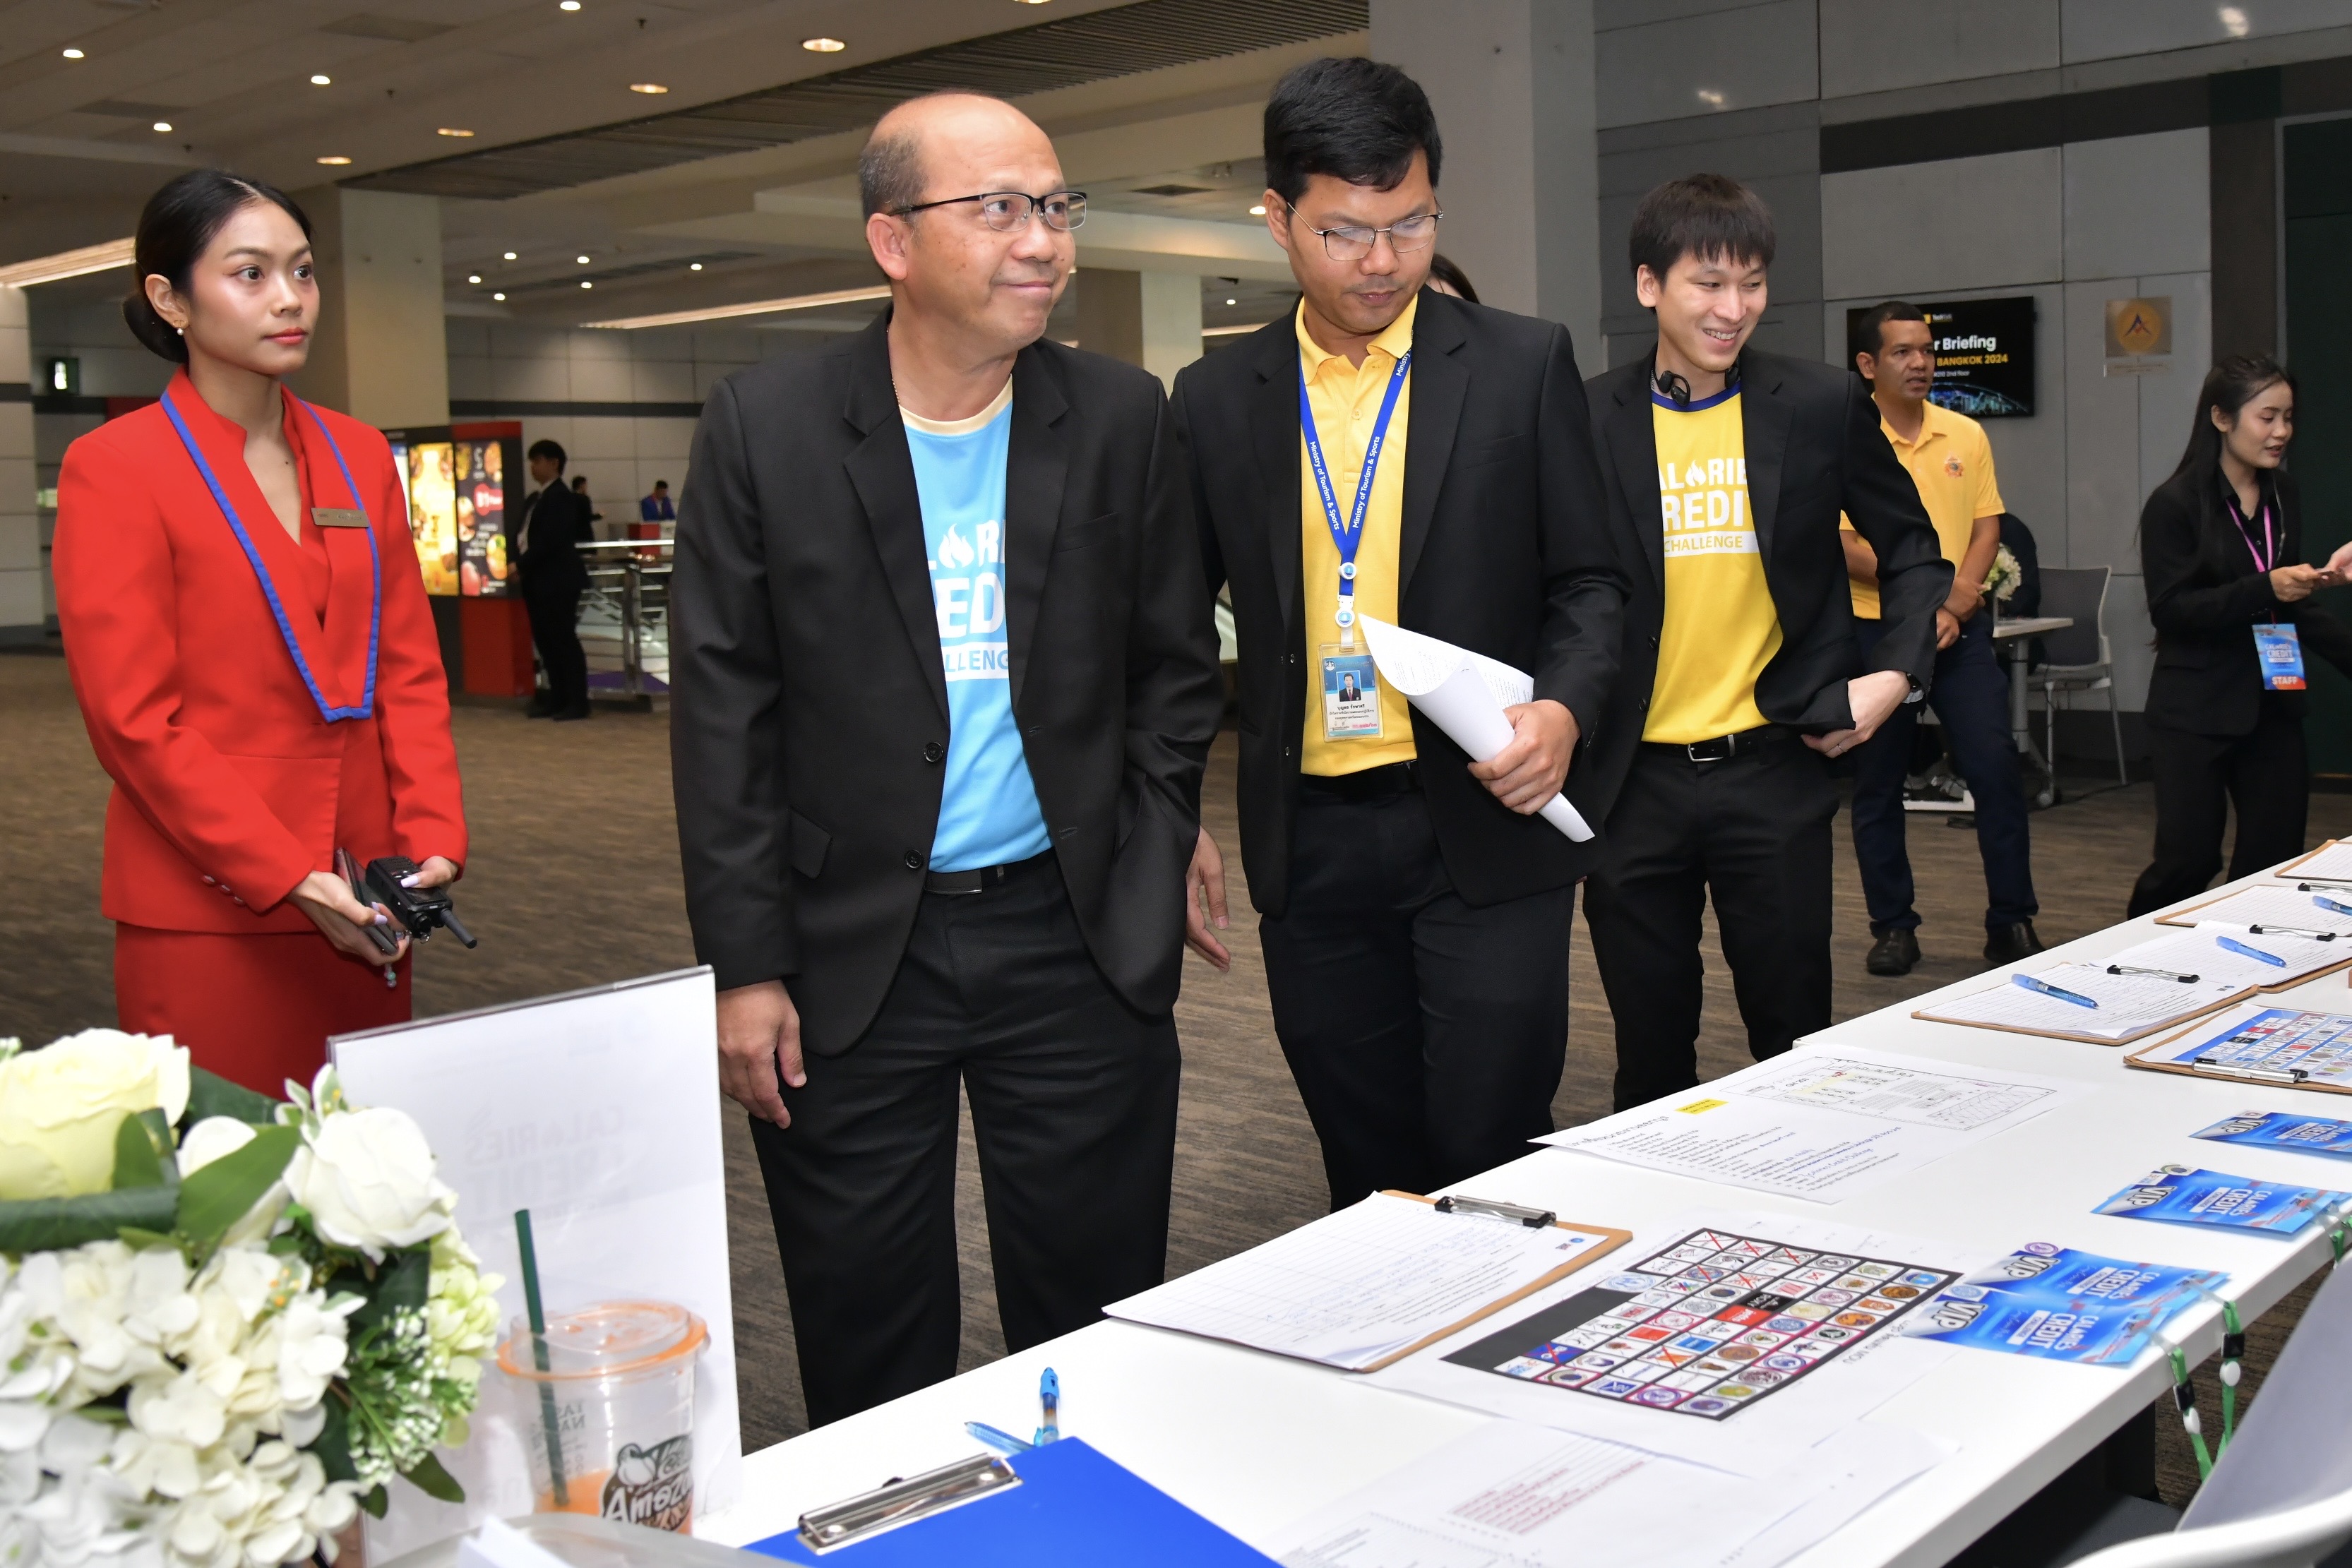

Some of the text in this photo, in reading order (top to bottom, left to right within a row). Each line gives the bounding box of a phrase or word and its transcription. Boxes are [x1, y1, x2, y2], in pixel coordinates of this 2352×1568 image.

[1942, 335, 1996, 352] Briefing
[1937, 354, 2008, 366] BANGKOK 2024
[1310, 441, 1320, 467] Ministry
[1320, 475, 1331, 501] Tourism
[1329, 509, 1339, 530] Sports
[1352, 501, 1365, 528] Ministry
[1360, 466, 1372, 491] Tourism
[1370, 436, 1380, 457] Sports
[1661, 490, 1749, 532] REDI
[1664, 536, 1743, 553] CHALLENGE
[2225, 1119, 2271, 1134] VIP
[2289, 1125, 2338, 1140] CREDIT
[2131, 1186, 2177, 1206] VIP
[2206, 1188, 2247, 1214] CREDIT
[2007, 1256, 2061, 1279] VIP
[2086, 1269, 2140, 1297] CREDIT
[1936, 1301, 1988, 1329] VIP
[2028, 1313, 2076, 1348] CREDIT
